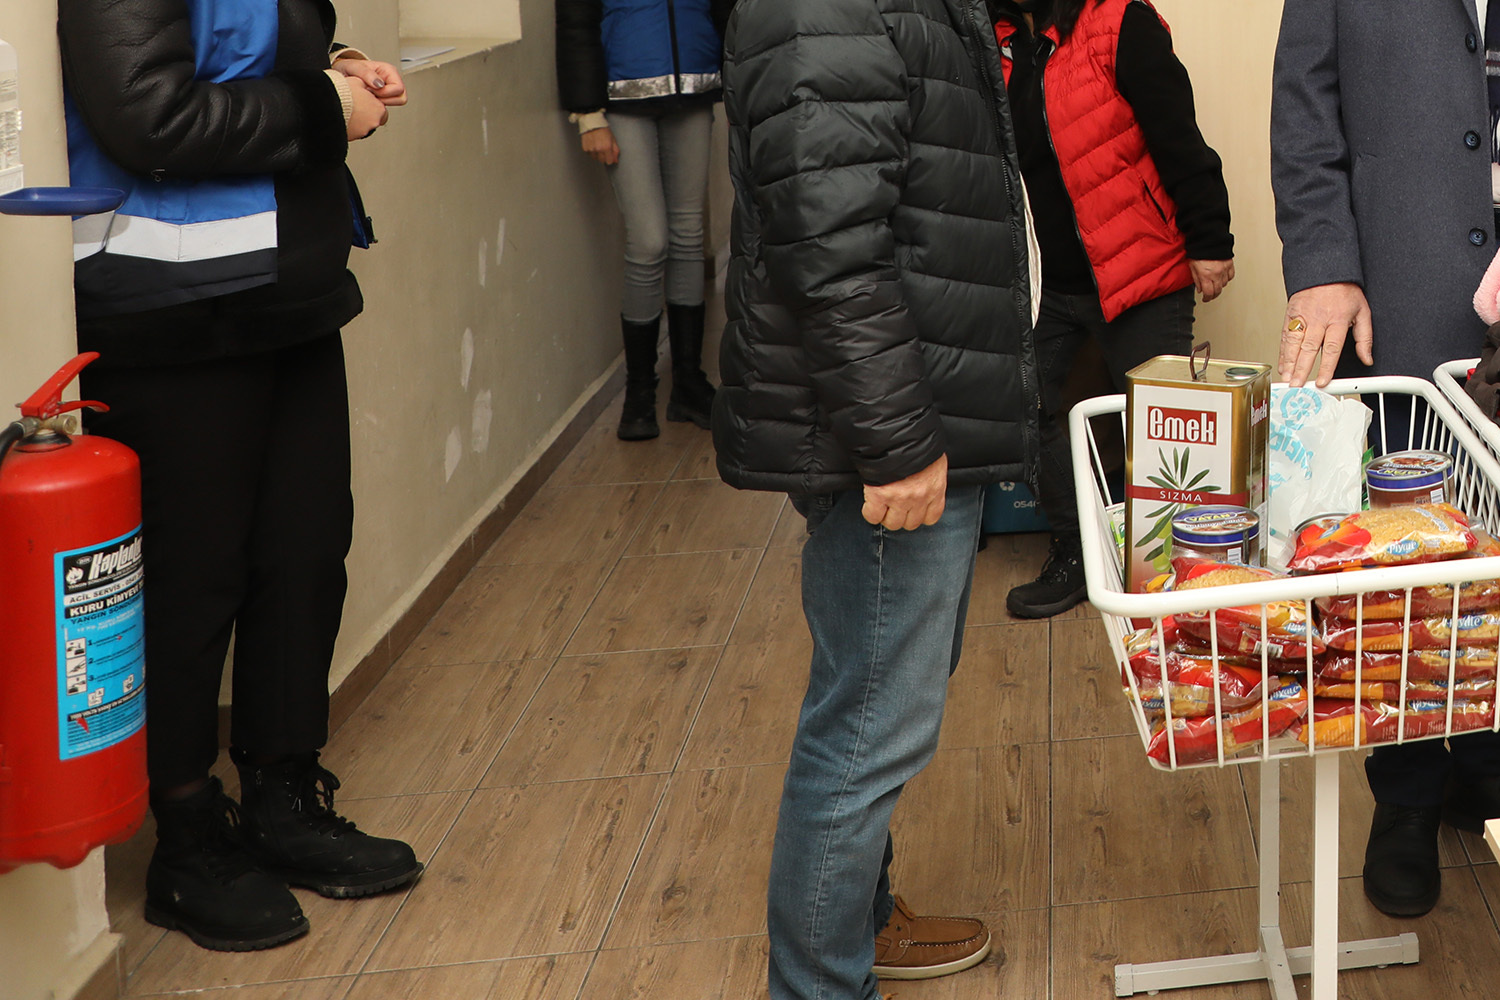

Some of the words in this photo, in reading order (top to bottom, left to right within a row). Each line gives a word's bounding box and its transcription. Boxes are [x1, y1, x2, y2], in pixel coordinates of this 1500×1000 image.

[1150, 407, 1215, 443] emek
[1160, 490, 1202, 502] SIZMA
[70, 600, 104, 617] KURU
[70, 610, 107, 625] YANGIN
